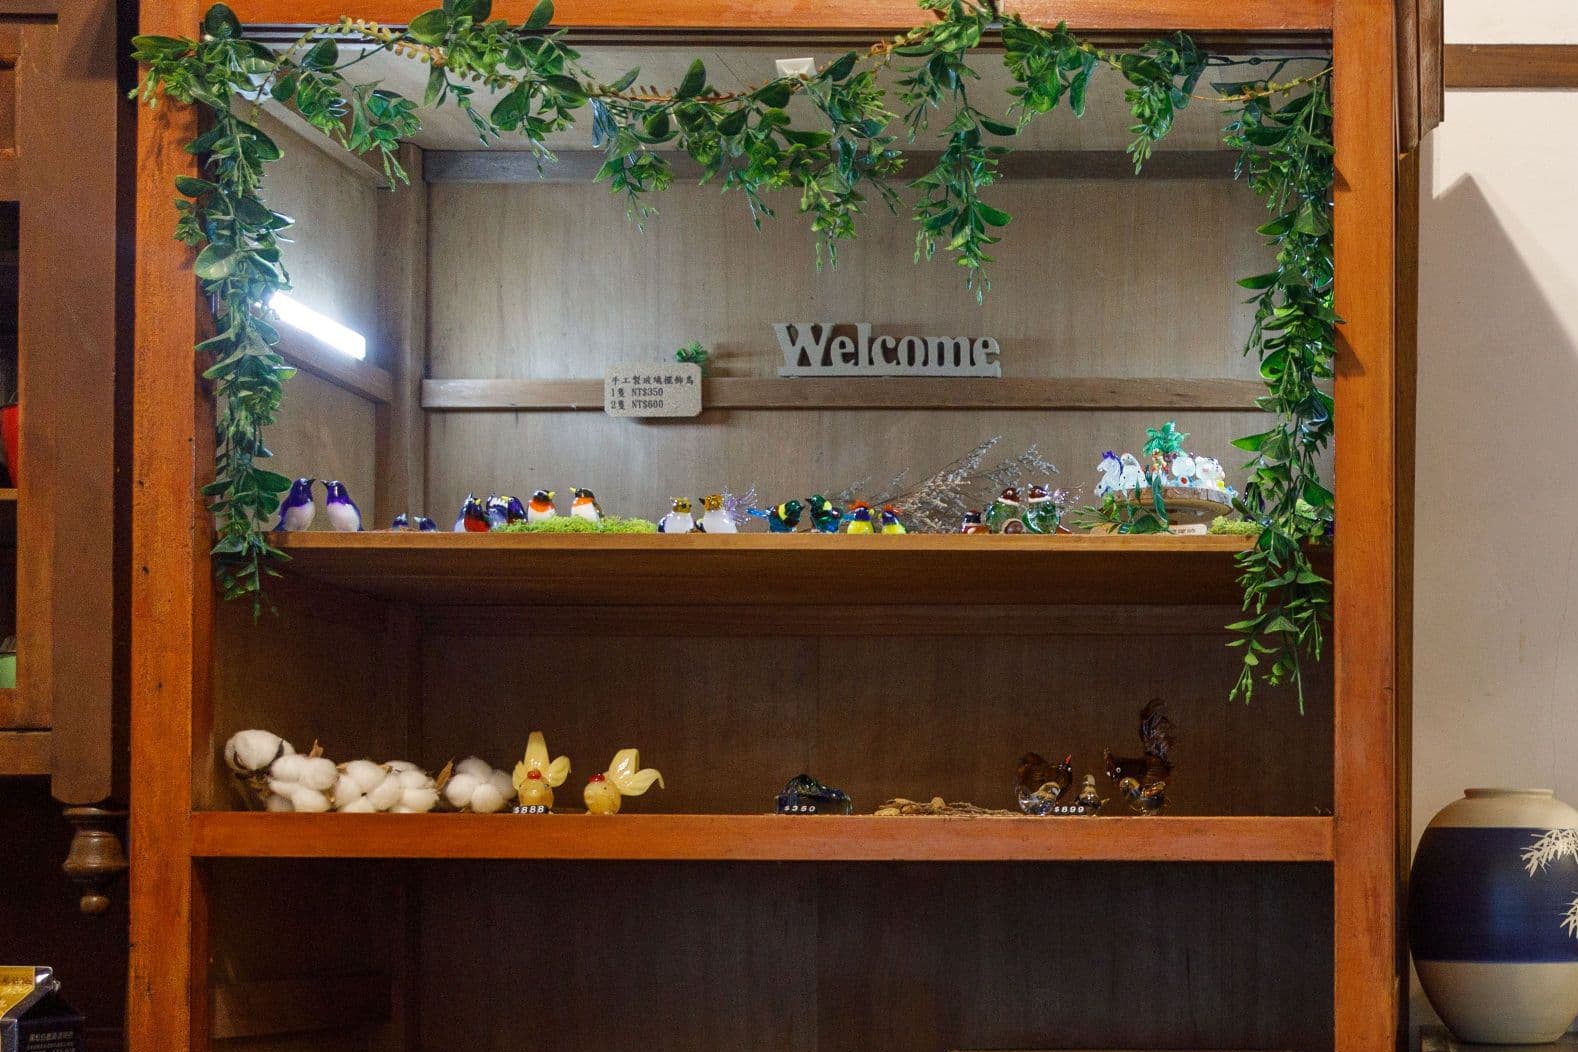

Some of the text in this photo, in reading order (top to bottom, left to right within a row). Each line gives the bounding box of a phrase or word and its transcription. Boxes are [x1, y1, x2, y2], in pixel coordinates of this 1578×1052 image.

[772, 322, 1001, 368] Welcome
[631, 387, 664, 397] NT$350
[631, 400, 664, 409] NT$600
